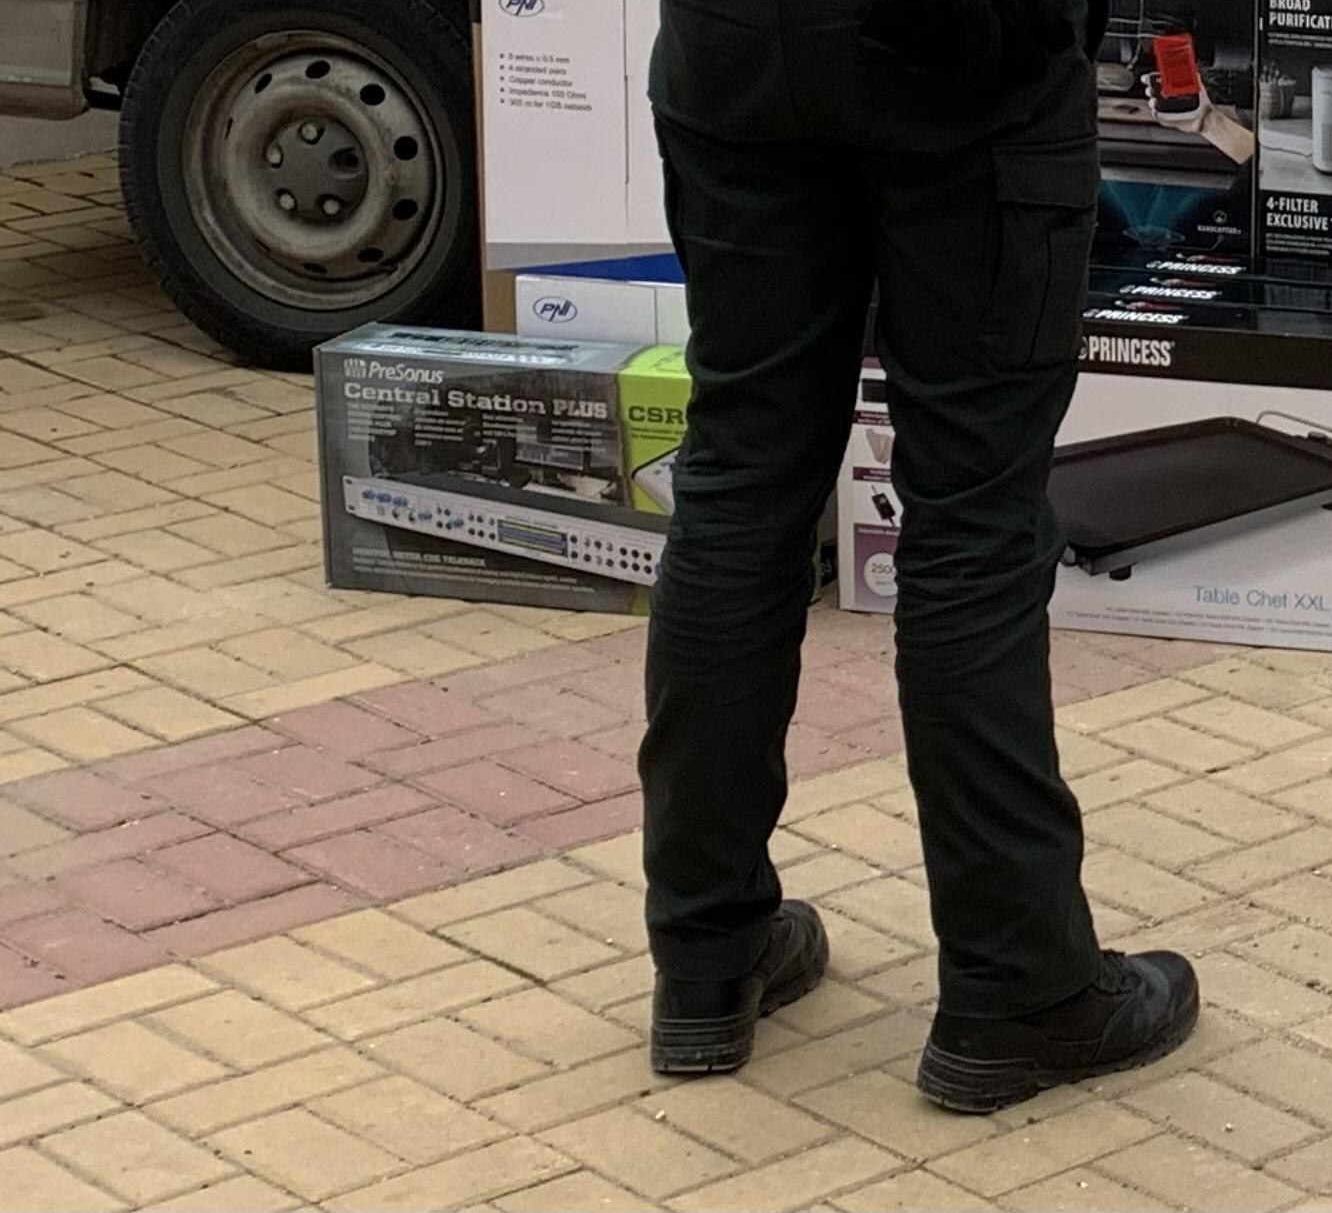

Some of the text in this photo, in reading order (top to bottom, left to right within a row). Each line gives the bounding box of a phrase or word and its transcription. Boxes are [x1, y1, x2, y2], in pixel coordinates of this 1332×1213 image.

[1266, 196, 1319, 213] 4-FILTER
[1266, 213, 1329, 231] EXCLUSIVE
[1158, 261, 1242, 274] PRINCESS
[1132, 286, 1217, 299] PRINCESS
[539, 300, 573, 321] PNI
[1096, 309, 1183, 323] PRINCESS
[1088, 335, 1172, 367] PRINCESS
[368, 361, 444, 384] PreSonus
[344, 382, 609, 420] Central Station PLUS
[1194, 586, 1240, 606] Table
[1246, 588, 1288, 609] Chef
[1293, 592, 1329, 612] XXL
